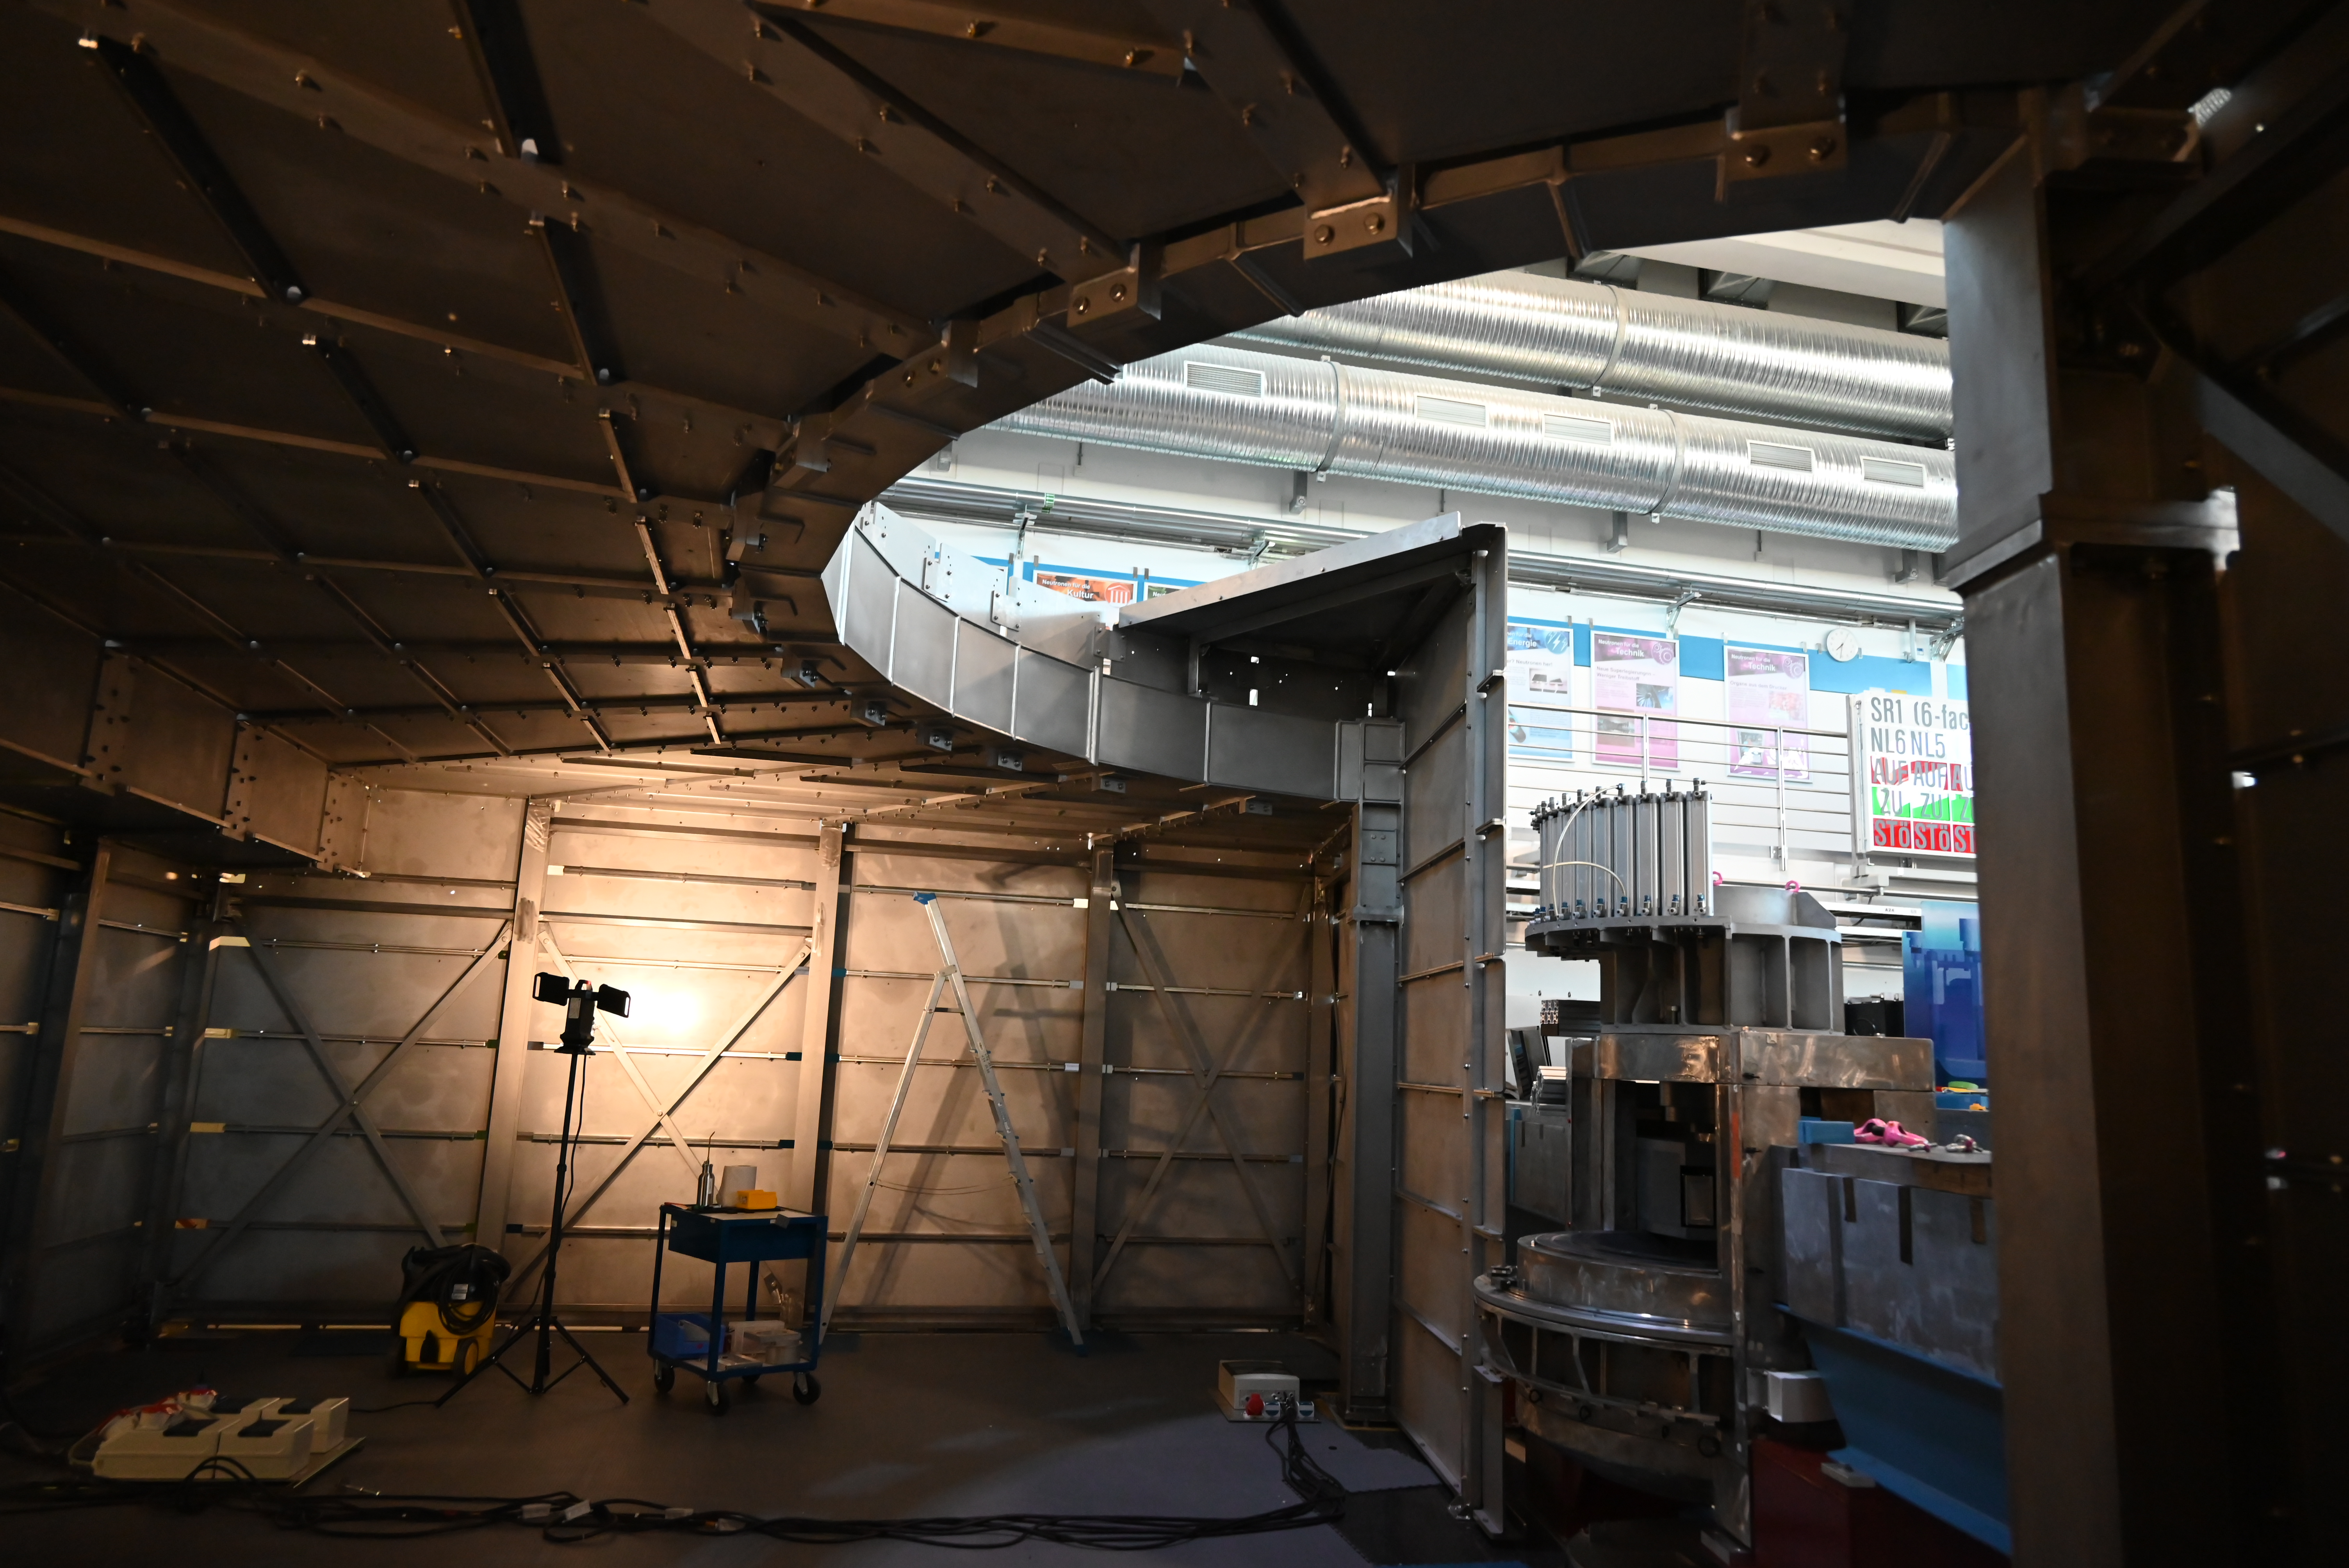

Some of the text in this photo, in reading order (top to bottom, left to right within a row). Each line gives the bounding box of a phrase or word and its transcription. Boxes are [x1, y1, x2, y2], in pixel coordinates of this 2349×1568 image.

[1042, 579, 1071, 587] Neutronen
[1067, 589, 1094, 599] Kultur
[1508, 638, 1537, 648] Energie
[1616, 647, 1644, 657] Technik
[1748, 662, 1775, 671] Technik
[1610, 668, 1651, 676] Superlegierungen
[1871, 697, 1902, 723] SR1
[1871, 727, 1945, 758] NL6 NL5
[1873, 758, 1908, 784] AUF
[1913, 761, 1946, 788] AUF
[1880, 789, 1902, 815] ZU
[1920, 793, 1942, 819] ZU
